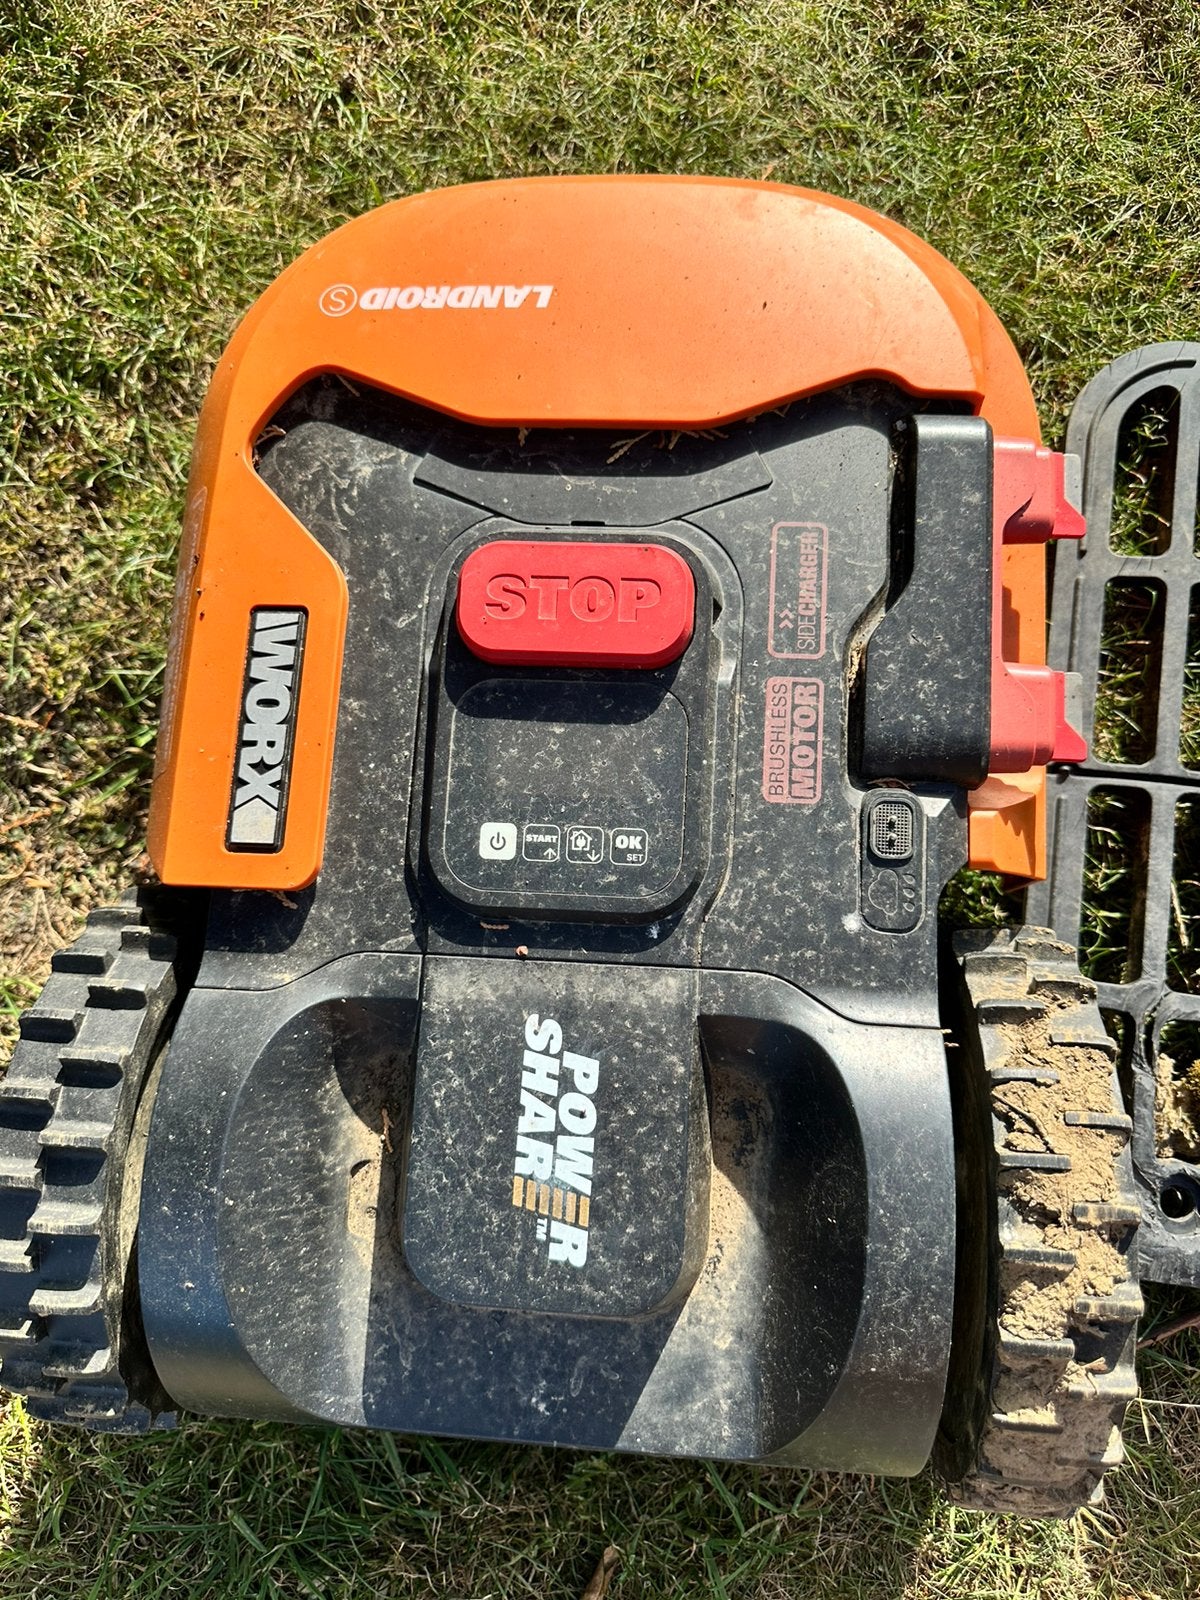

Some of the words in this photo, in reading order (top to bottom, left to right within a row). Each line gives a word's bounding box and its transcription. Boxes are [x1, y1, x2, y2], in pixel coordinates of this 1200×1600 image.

[359, 285, 554, 310] LANDROID
[484, 573, 662, 623] STOP
[797, 531, 819, 650] SIDECHARGER
[234, 621, 298, 811] WORX
[768, 683, 788, 796] BRUSHLESS
[791, 684, 819, 797] MOTOR
[525, 833, 558, 843] START
[615, 835, 643, 850] OK
[626, 853, 644, 862] SET
[548, 1050, 600, 1268] POWER
